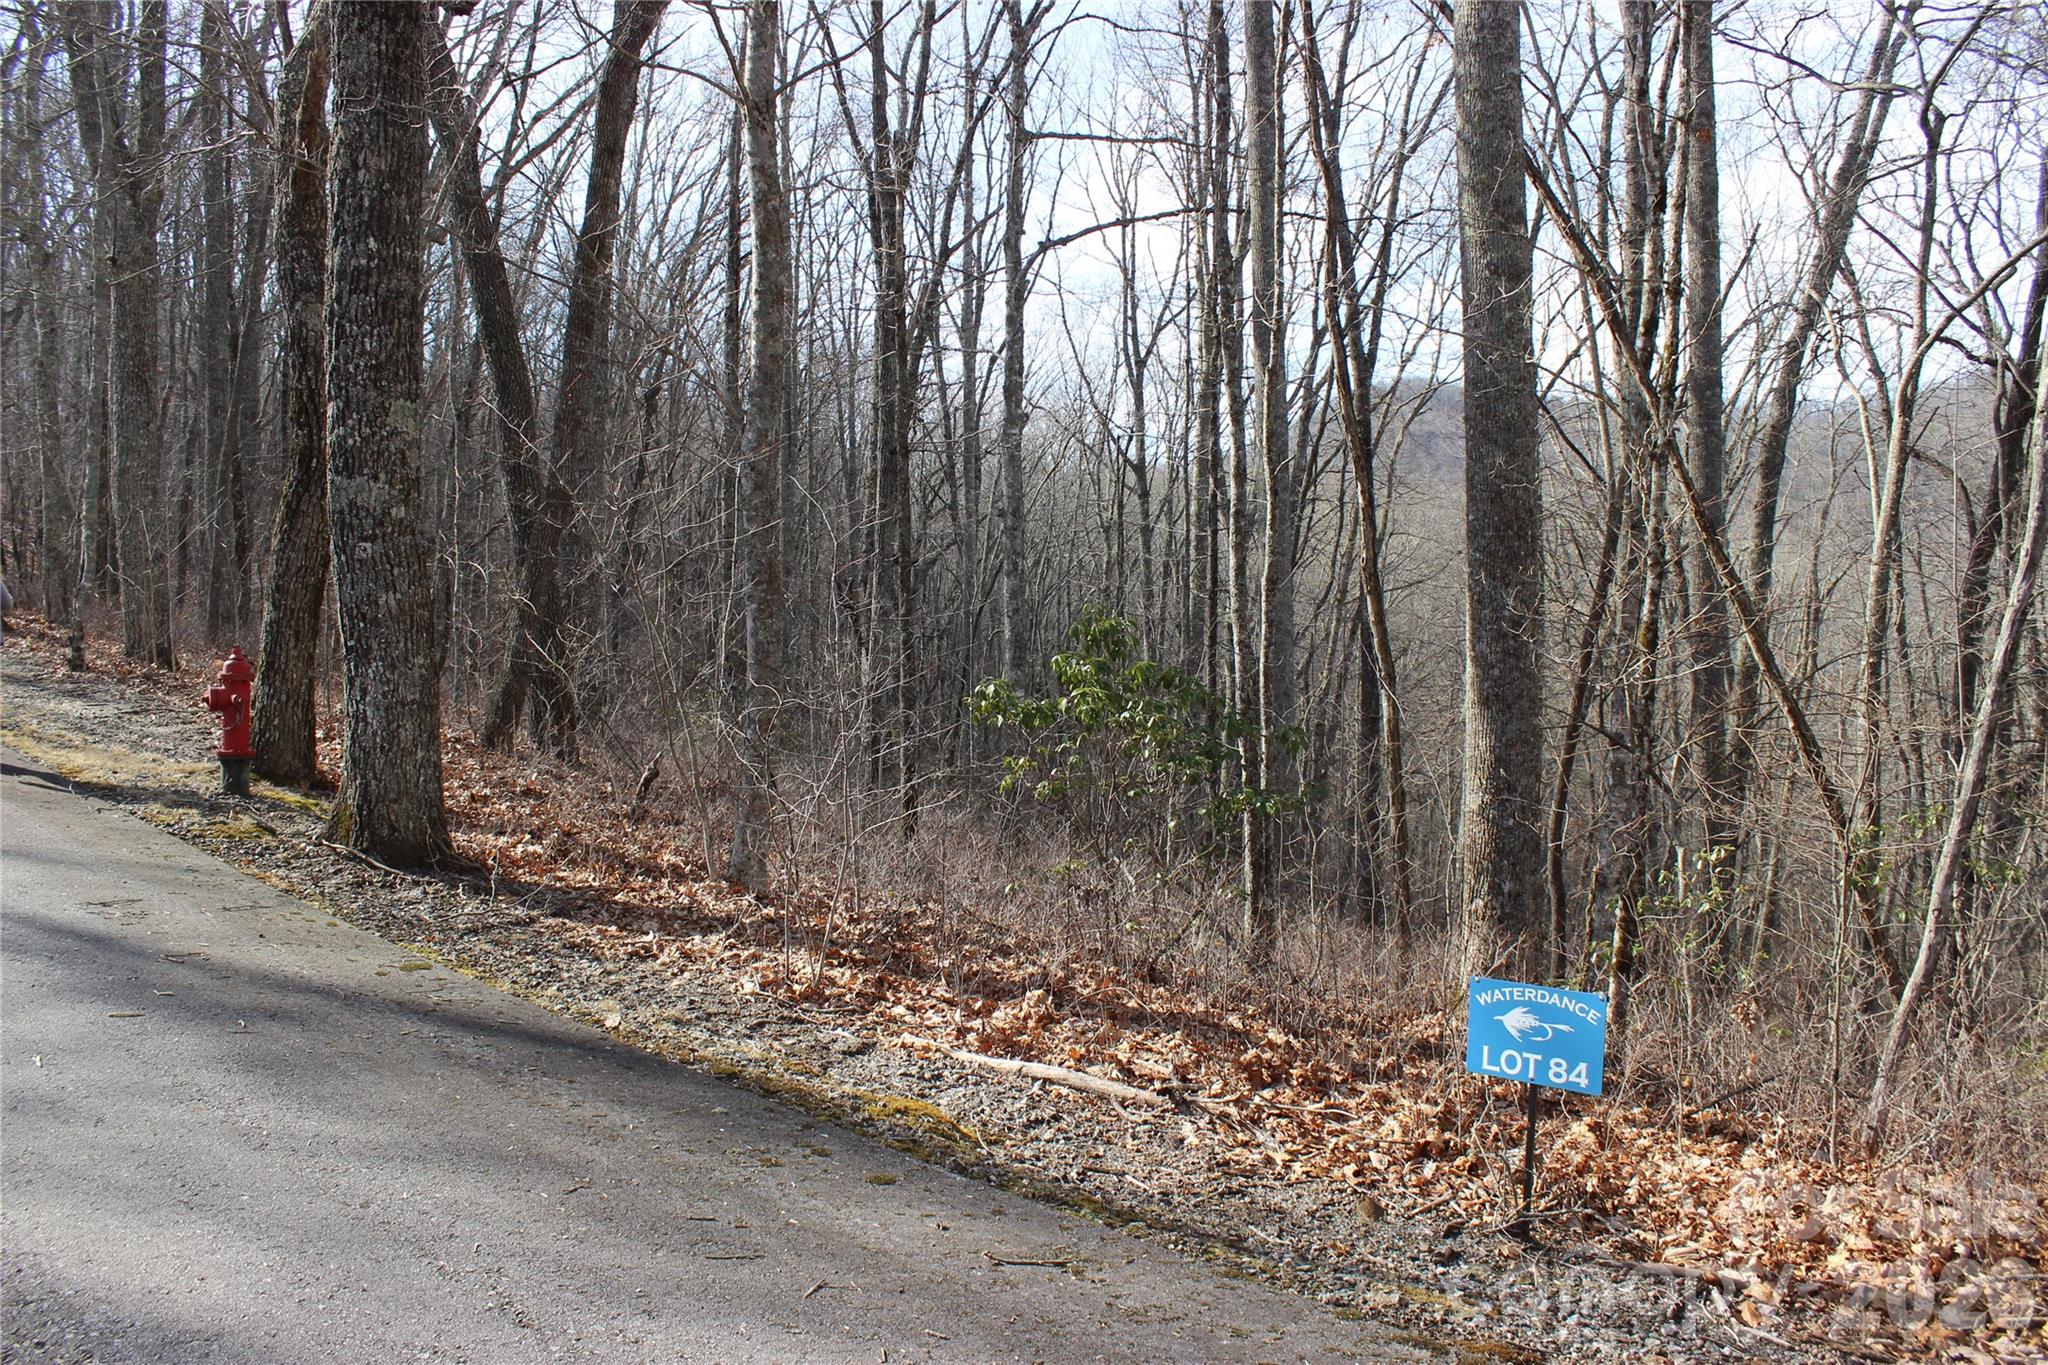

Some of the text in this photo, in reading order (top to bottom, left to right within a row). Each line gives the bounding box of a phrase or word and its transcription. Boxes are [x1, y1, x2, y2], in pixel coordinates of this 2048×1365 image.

[1475, 987, 1601, 1025] WATERDANCE
[1482, 1045, 1589, 1088] LOT 84
